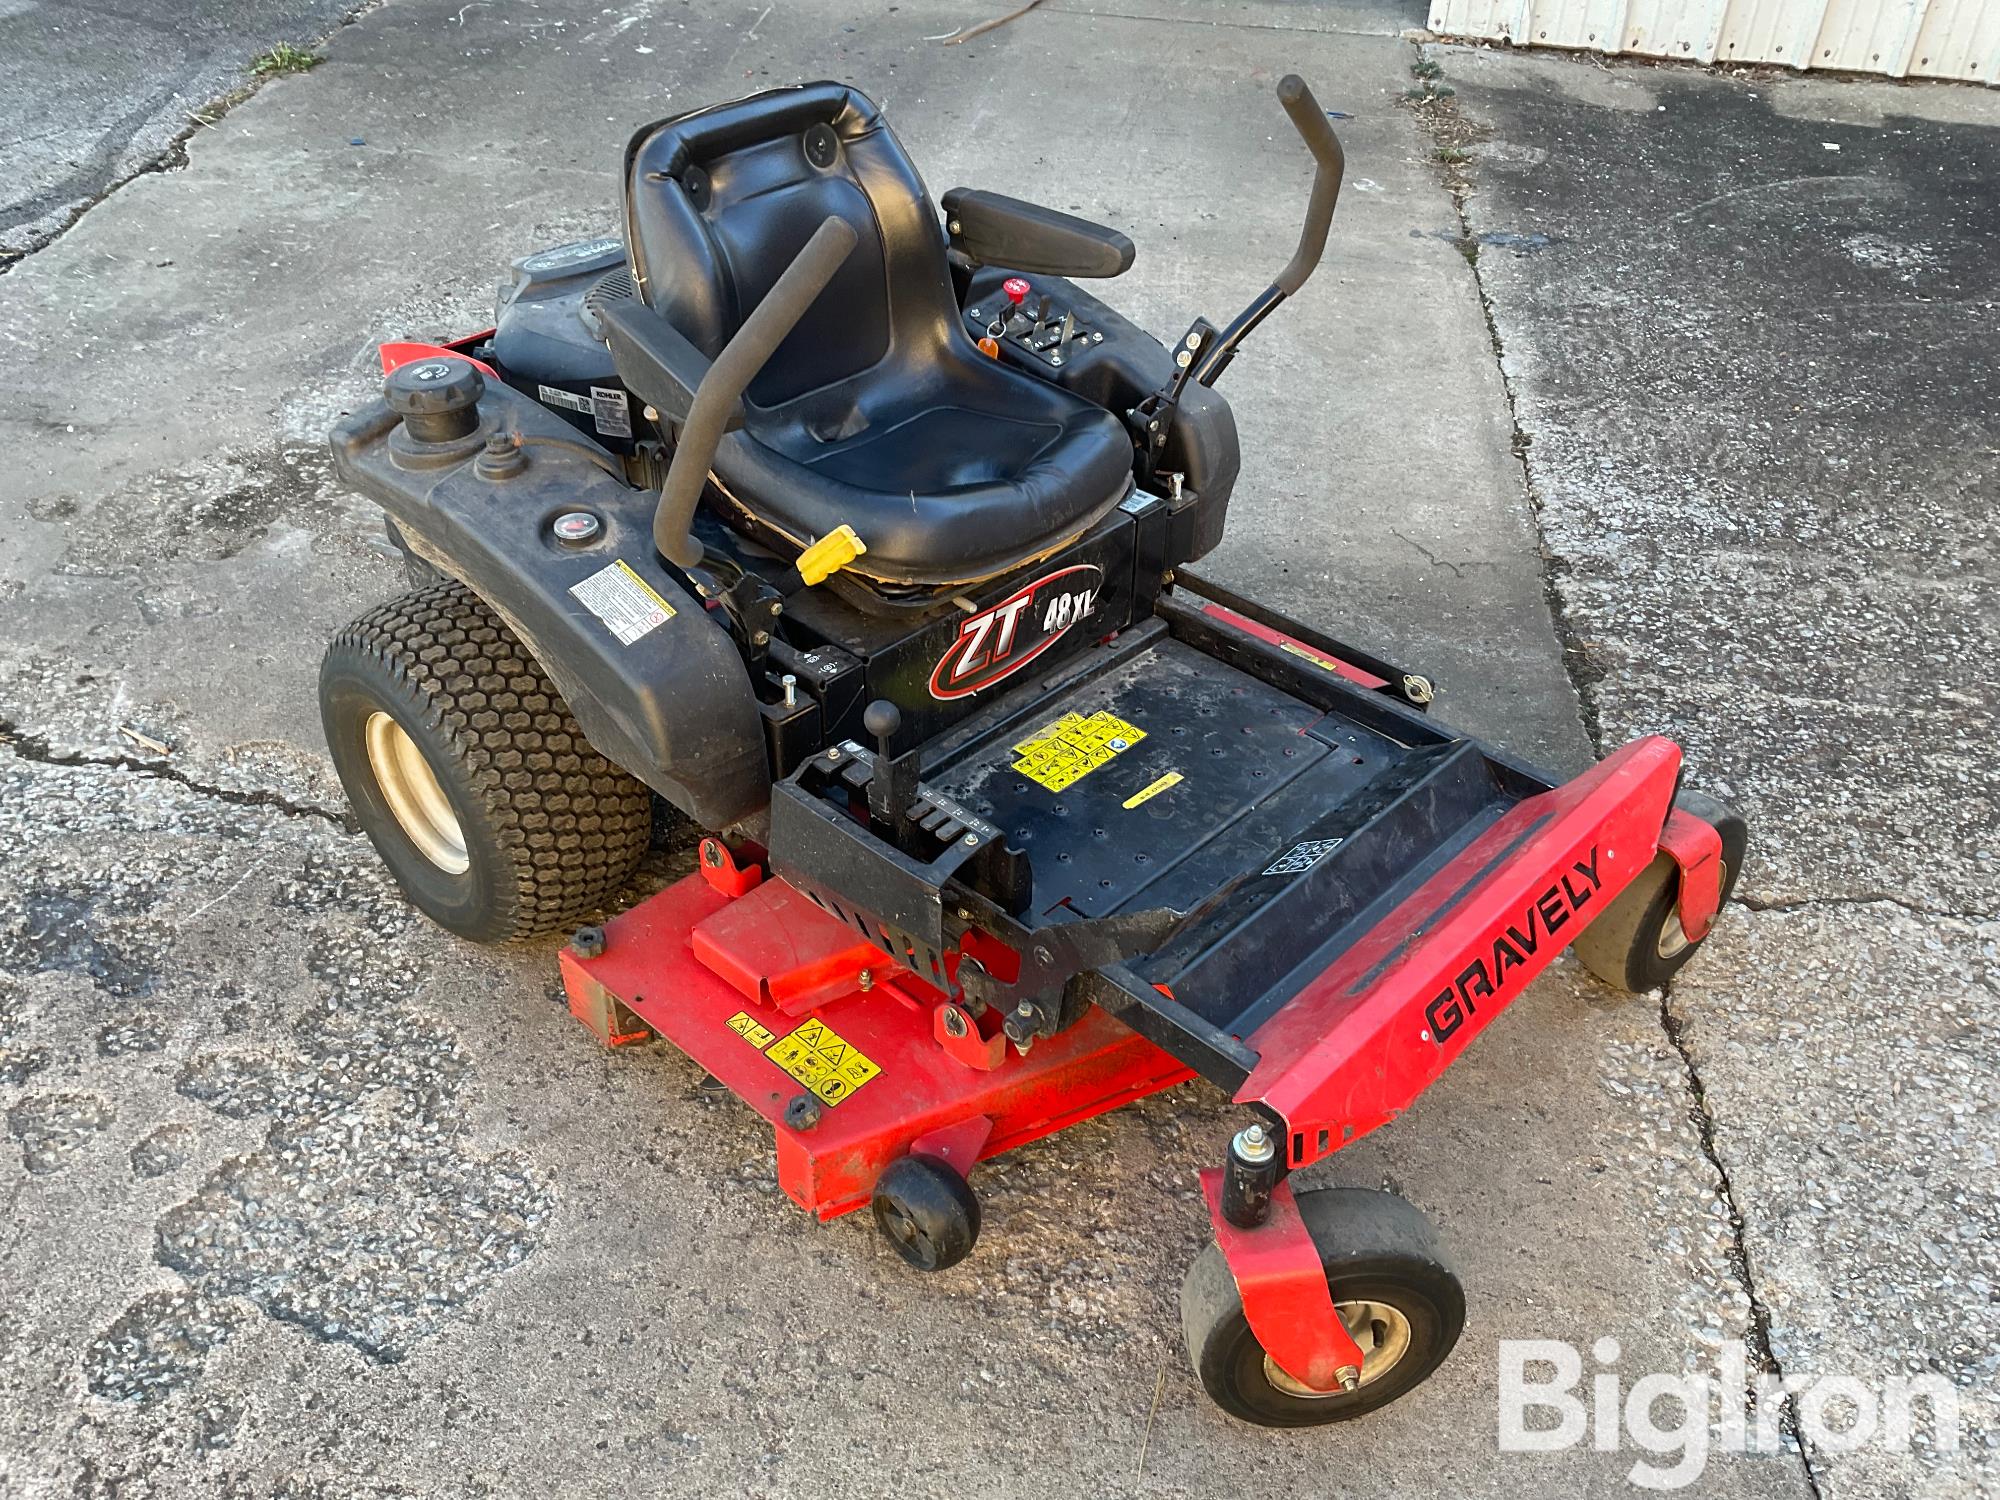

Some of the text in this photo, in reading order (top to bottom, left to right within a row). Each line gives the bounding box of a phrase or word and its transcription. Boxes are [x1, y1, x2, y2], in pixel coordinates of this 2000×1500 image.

[596, 391, 622, 400] KOHLER
[953, 594, 1031, 679] ZT
[1425, 845, 1602, 1044] GRAVELY
